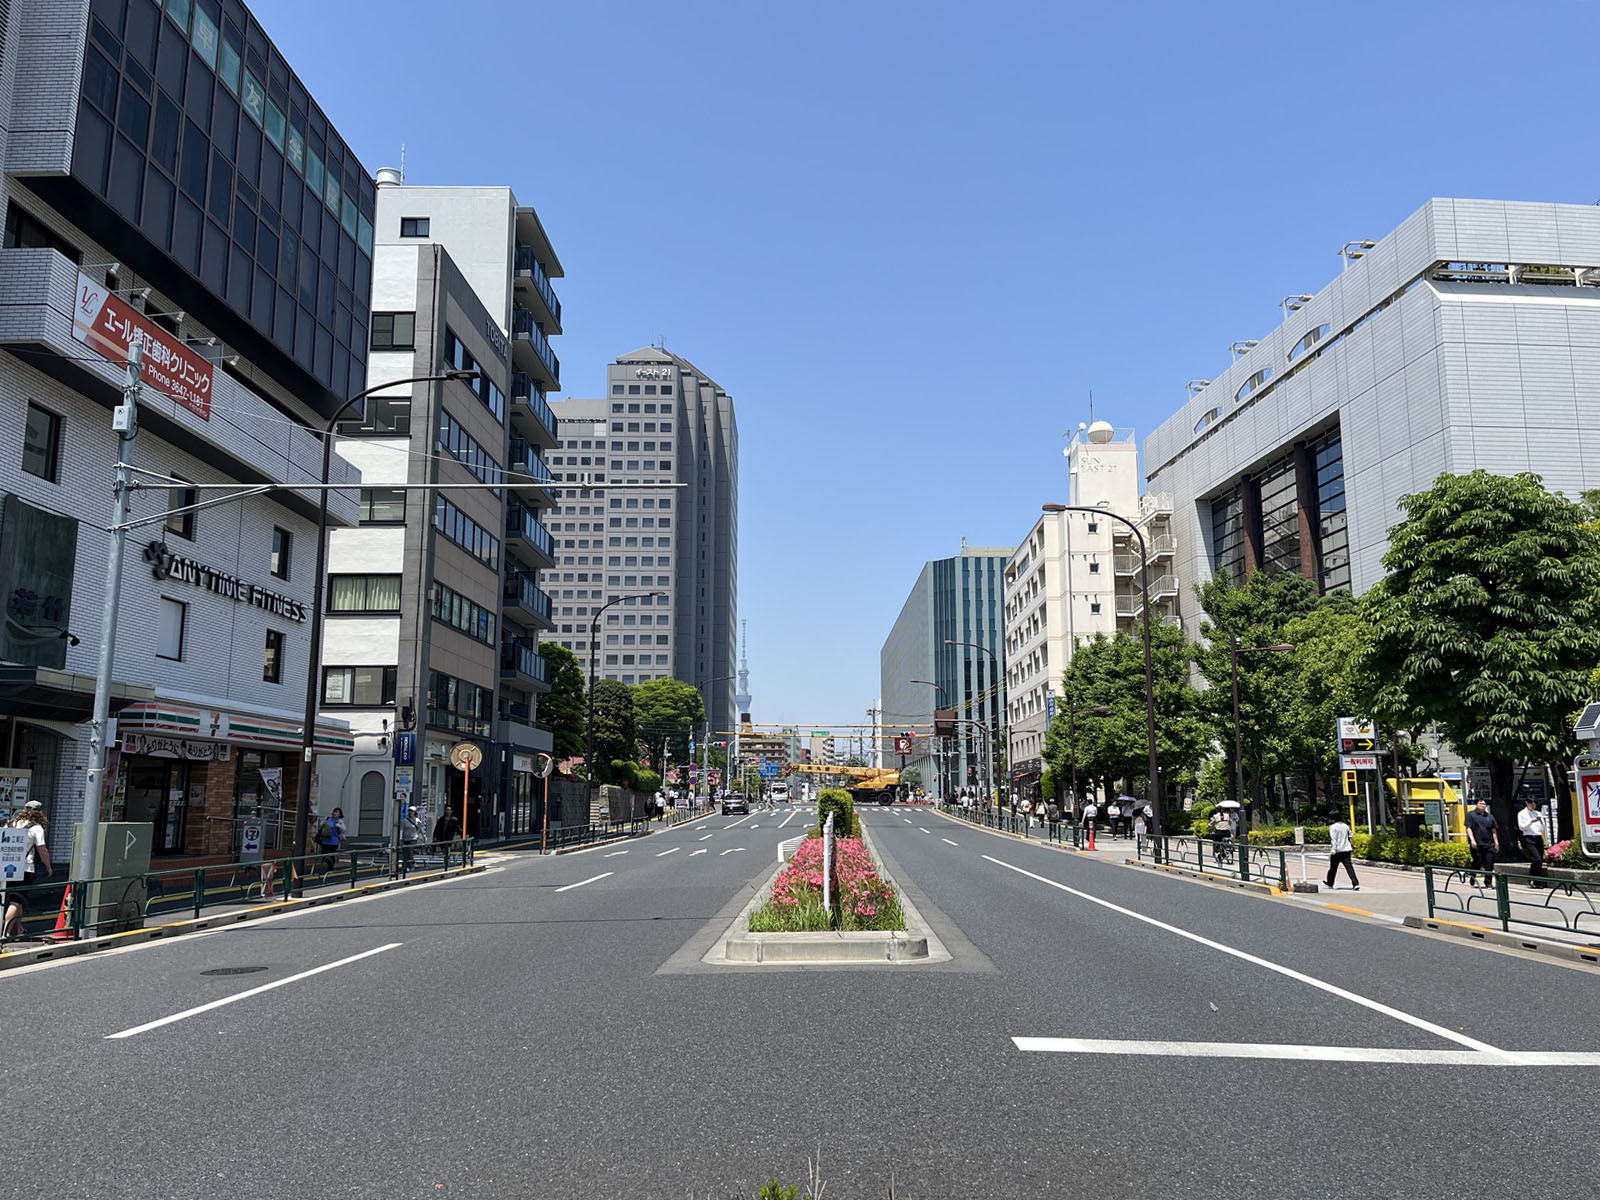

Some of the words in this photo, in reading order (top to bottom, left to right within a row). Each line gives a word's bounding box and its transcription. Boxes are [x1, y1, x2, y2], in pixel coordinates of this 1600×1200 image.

[486, 319, 508, 361] TOBITA
[104, 308, 210, 394] エール矯正歯科クリニック
[148, 364, 171, 388] Phone
[635, 368, 660, 376] イースト
[661, 368, 671, 376] 21
[1081, 457, 1101, 465] SUN
[1081, 465, 1105, 473] EAST
[1107, 465, 1118, 473] 21
[169, 554, 249, 602] ANYTIME
[252, 584, 308, 623] FITNESS
[1343, 739, 1354, 751] P
